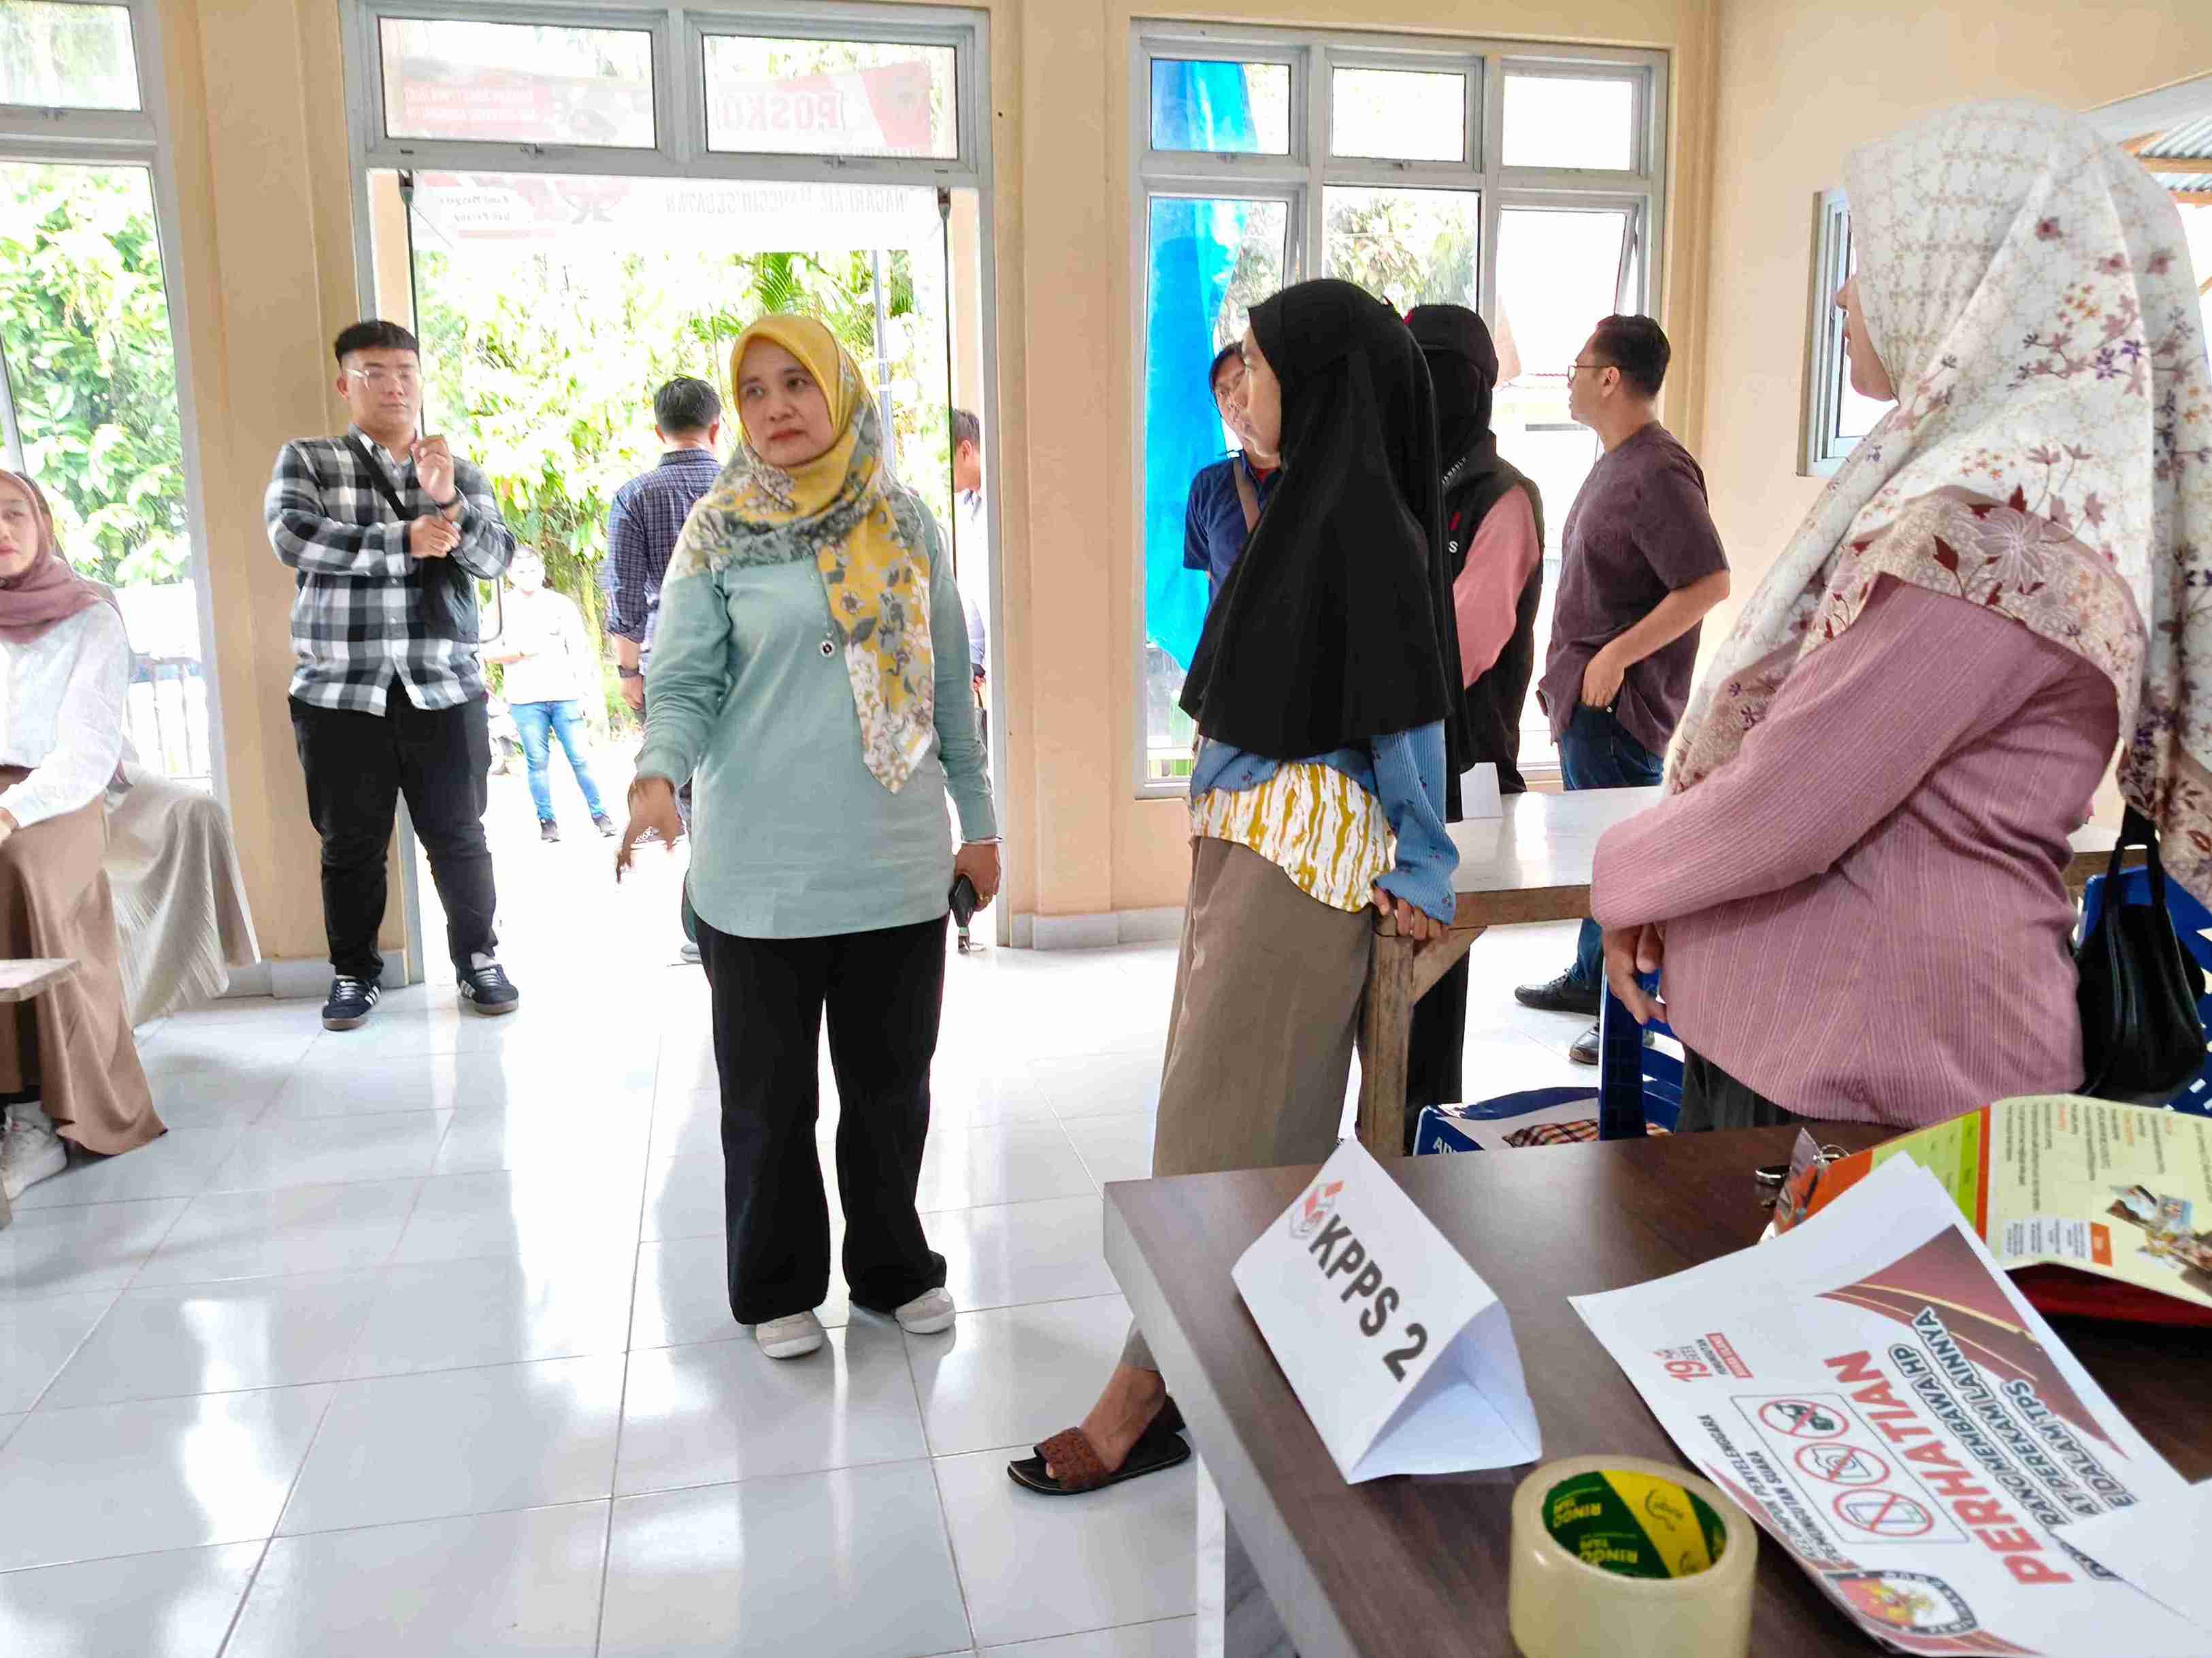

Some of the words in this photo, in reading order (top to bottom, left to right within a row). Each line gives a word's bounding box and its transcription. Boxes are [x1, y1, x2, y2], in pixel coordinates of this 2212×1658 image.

[1308, 1214, 1400, 1337] KPPS
[1383, 1323, 1427, 1382] 2
[1894, 1346, 1926, 1375] HP
[1915, 1309, 1990, 1401] LAINNYA
[1916, 1377, 2011, 1472] MEMBAWA
[2007, 1380, 2049, 1421] TPS
[1746, 1450, 1783, 1485] SUARA
[1823, 1349, 2075, 1585] PERHATIAN
[1986, 1403, 2075, 1489] PEREKAM
[2041, 1424, 2119, 1491] DALAM
[2061, 1491, 2100, 1515] AT
[2107, 1495, 2135, 1508] E
